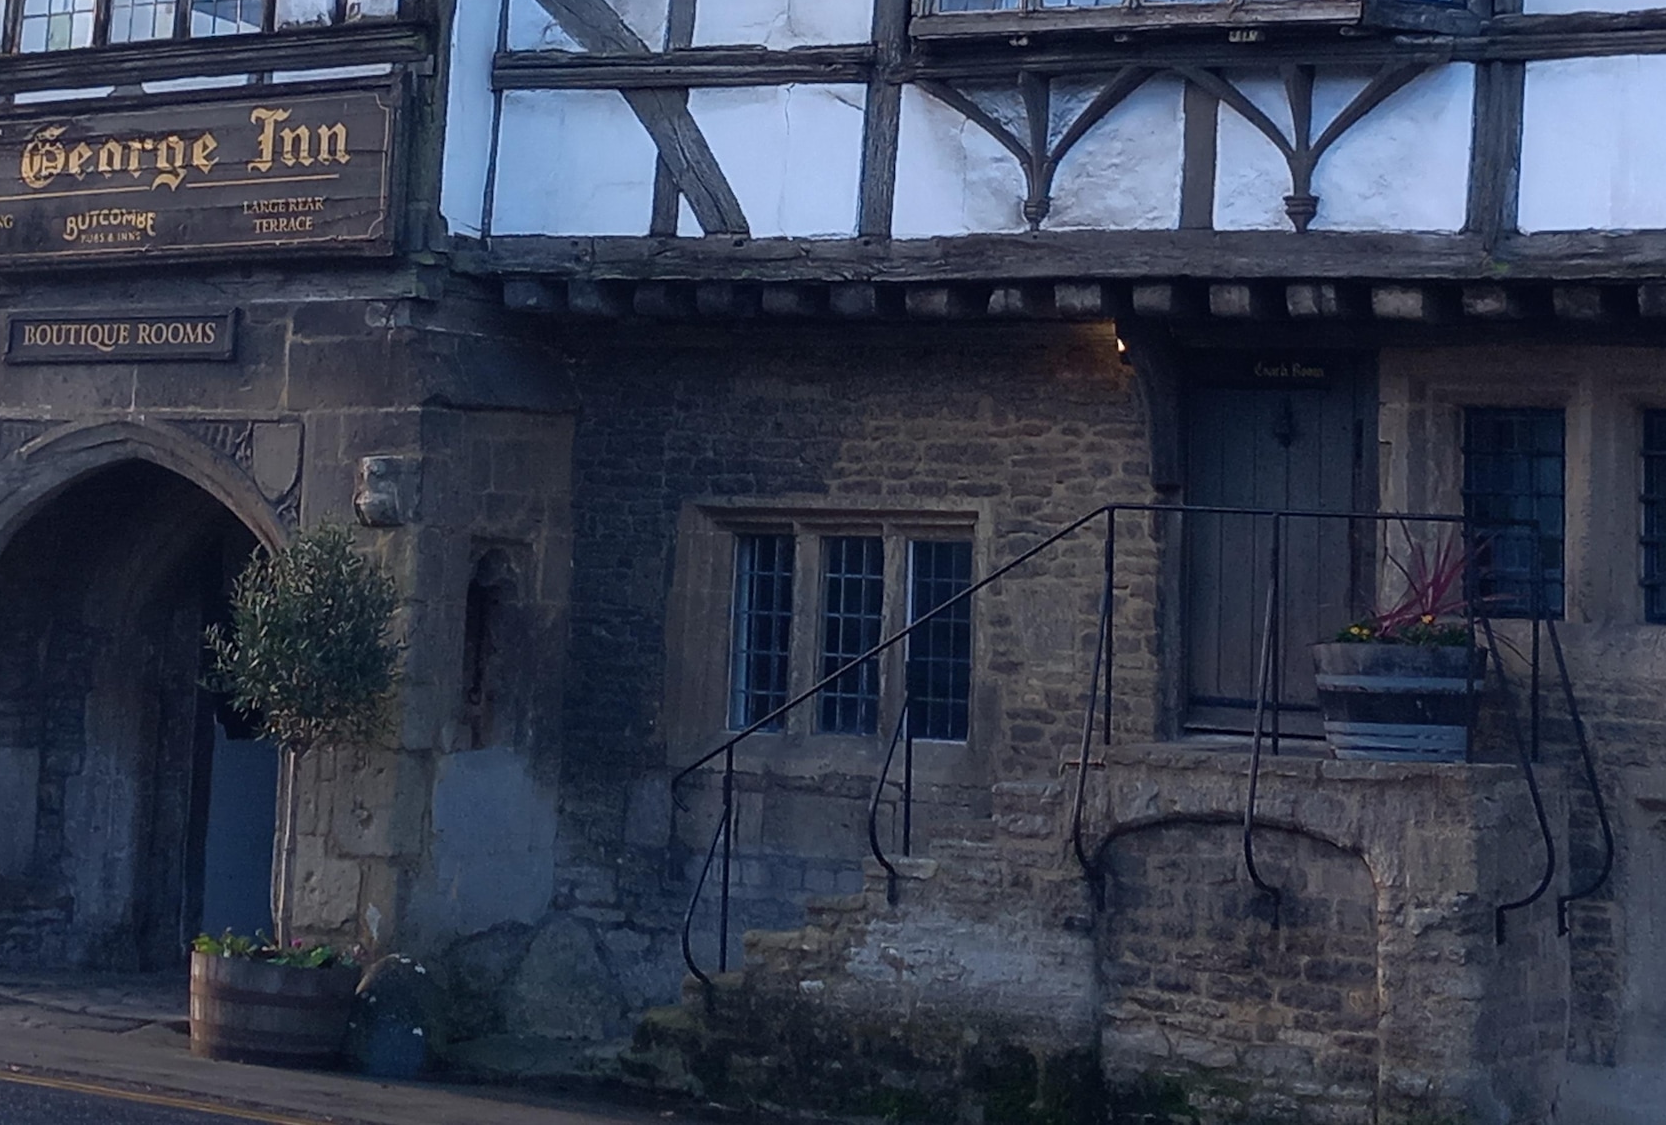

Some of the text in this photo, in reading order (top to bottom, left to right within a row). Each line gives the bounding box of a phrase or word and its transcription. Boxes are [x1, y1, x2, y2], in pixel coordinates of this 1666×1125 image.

[18, 125, 219, 191] George
[248, 108, 351, 173] Inn
[243, 196, 325, 215] LARGE REAR
[62, 208, 157, 241] BUTCOMBE
[252, 216, 313, 234] TERRACE
[80, 231, 142, 244] PUBS & INNS
[22, 322, 216, 352] BOUTIQUE ROOMS
[1291, 361, 1325, 378] Room
